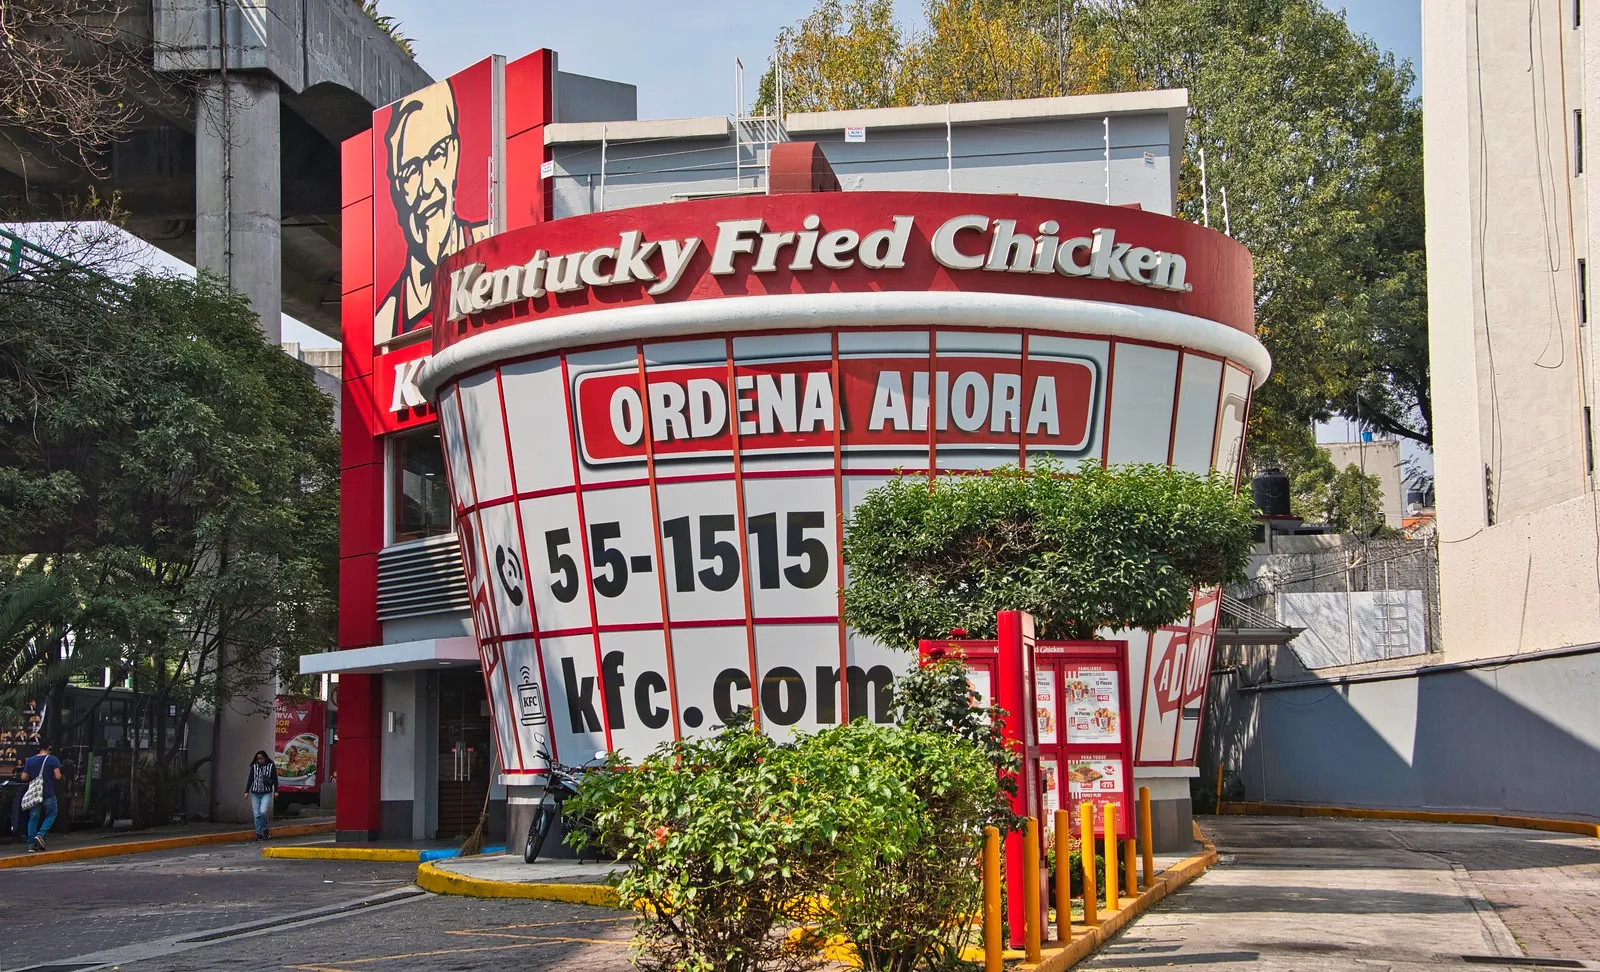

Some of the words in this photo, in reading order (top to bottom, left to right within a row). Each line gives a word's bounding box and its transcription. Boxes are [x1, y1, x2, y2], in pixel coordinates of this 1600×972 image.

[447, 229, 702, 322] Kentucky
[710, 213, 915, 276] Fried
[931, 214, 1189, 292] Chicken
[609, 371, 845, 446] ORDENA
[869, 370, 1060, 435] AHORA
[545, 511, 830, 604] 55-1515
[523, 695, 538, 708] KFC
[561, 650, 894, 734] kfc.com
